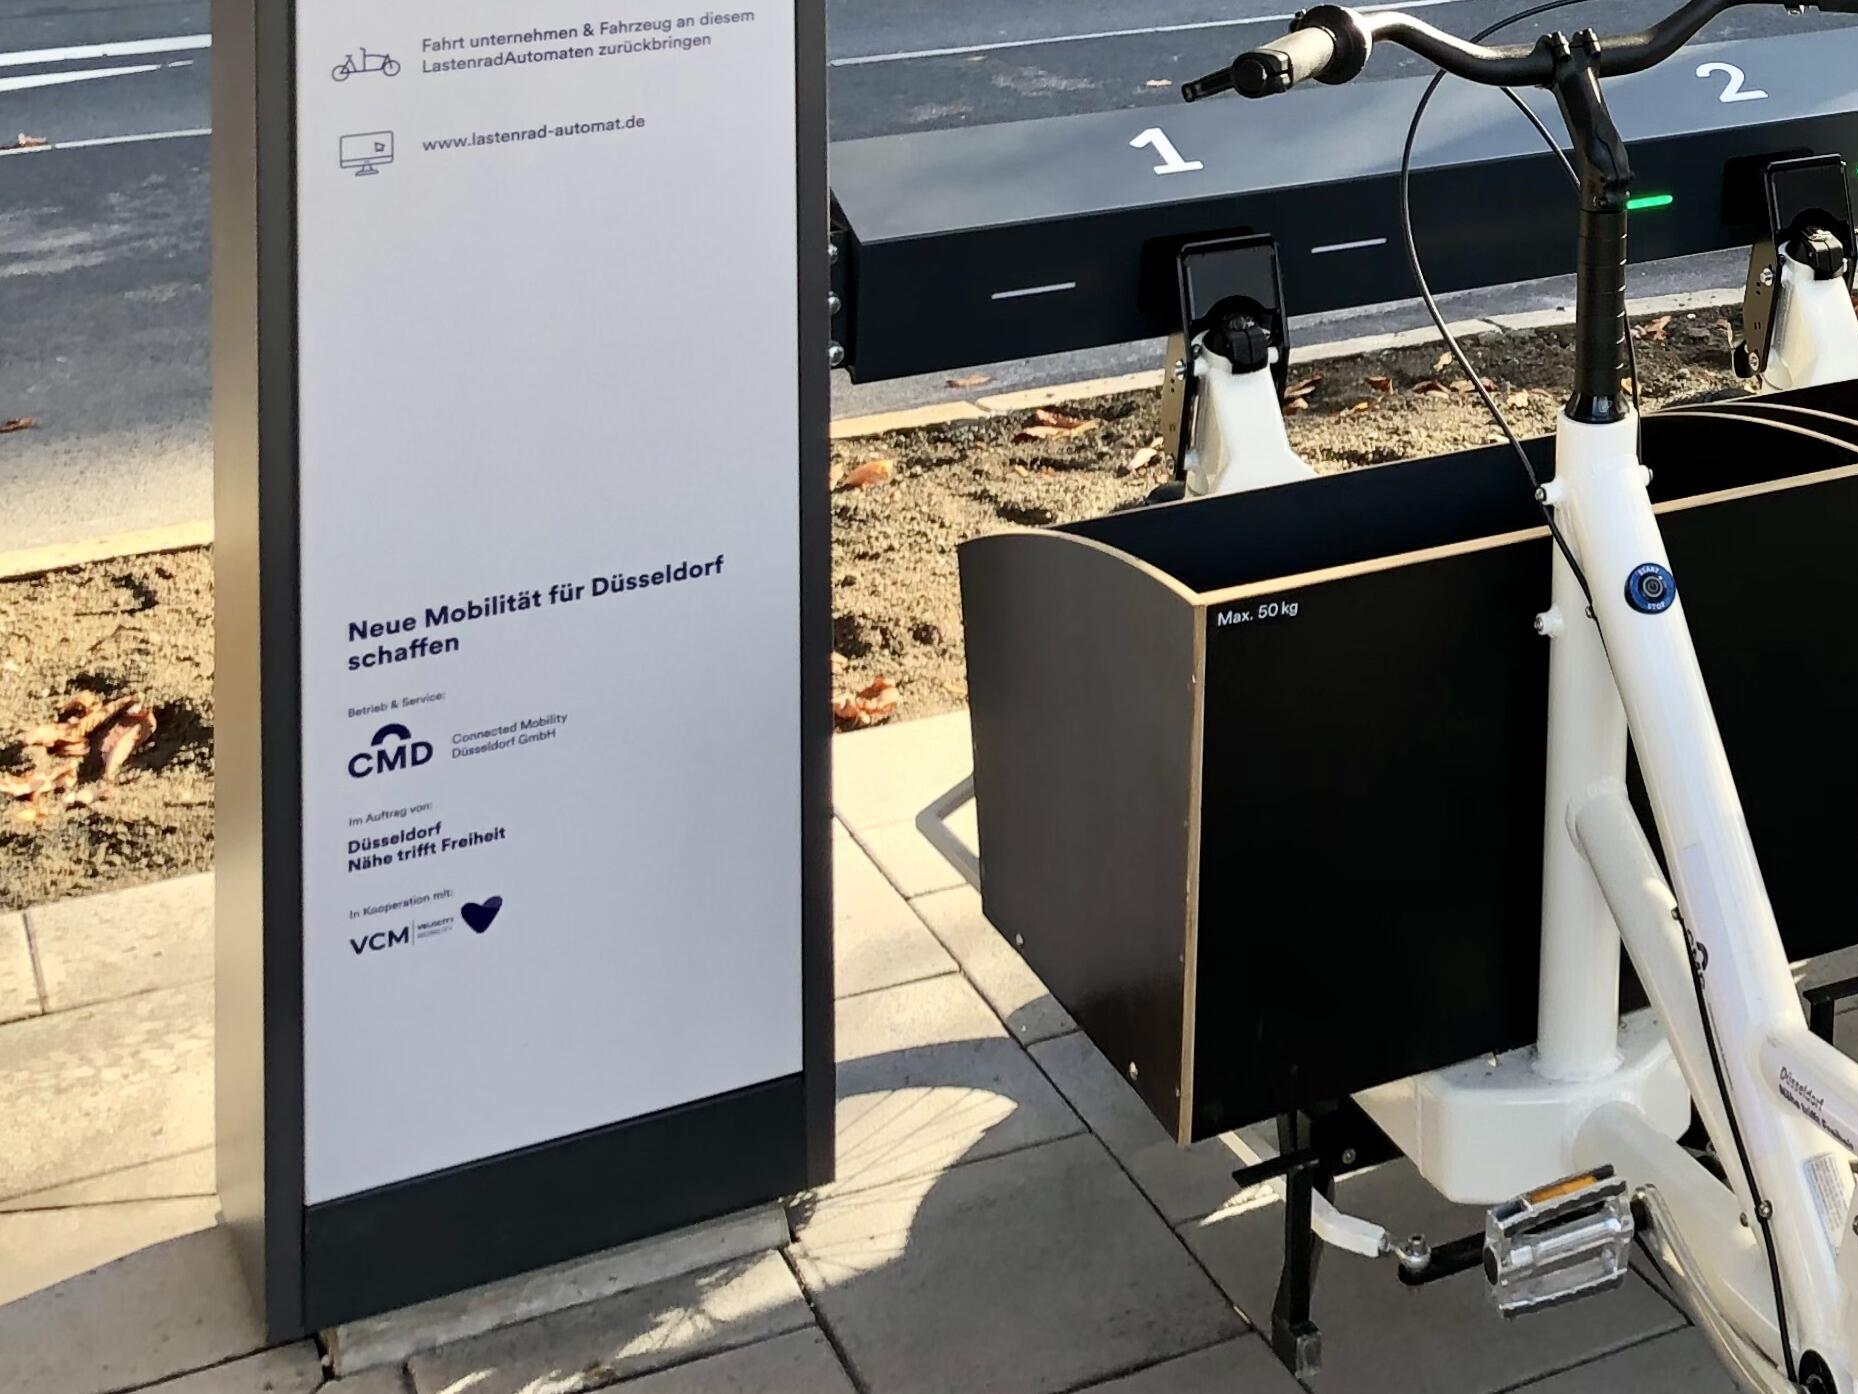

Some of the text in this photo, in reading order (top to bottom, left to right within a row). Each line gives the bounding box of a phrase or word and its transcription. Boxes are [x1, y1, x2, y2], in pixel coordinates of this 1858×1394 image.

[422, 10, 755, 53] Fahrt unternehmen & Fahrzeug an diesem
[422, 33, 711, 73] LastenradAutomaten zurückbringen
[1695, 61, 1769, 103] 2
[422, 115, 646, 152] www.lastenrad-automat.de
[1128, 127, 1204, 175] 1
[348, 554, 725, 642] Neue Mobilität für Düsseldorf
[1217, 601, 1299, 627] Max. 50 kg
[347, 636, 460, 671] schaffen
[348, 702, 388, 718] Betrieb
[391, 699, 399, 710] &
[451, 728, 556, 759] Düsseldorf GmbH
[452, 713, 568, 745] Connected Mobility
[347, 740, 434, 779] CMD
[349, 802, 433, 828] Im Auftrag von:
[347, 821, 442, 854] Düsseldorf
[347, 826, 506, 873] Nähe trifft Freiheit
[363, 893, 430, 916] Kooperation
[349, 926, 409, 955] VCM
